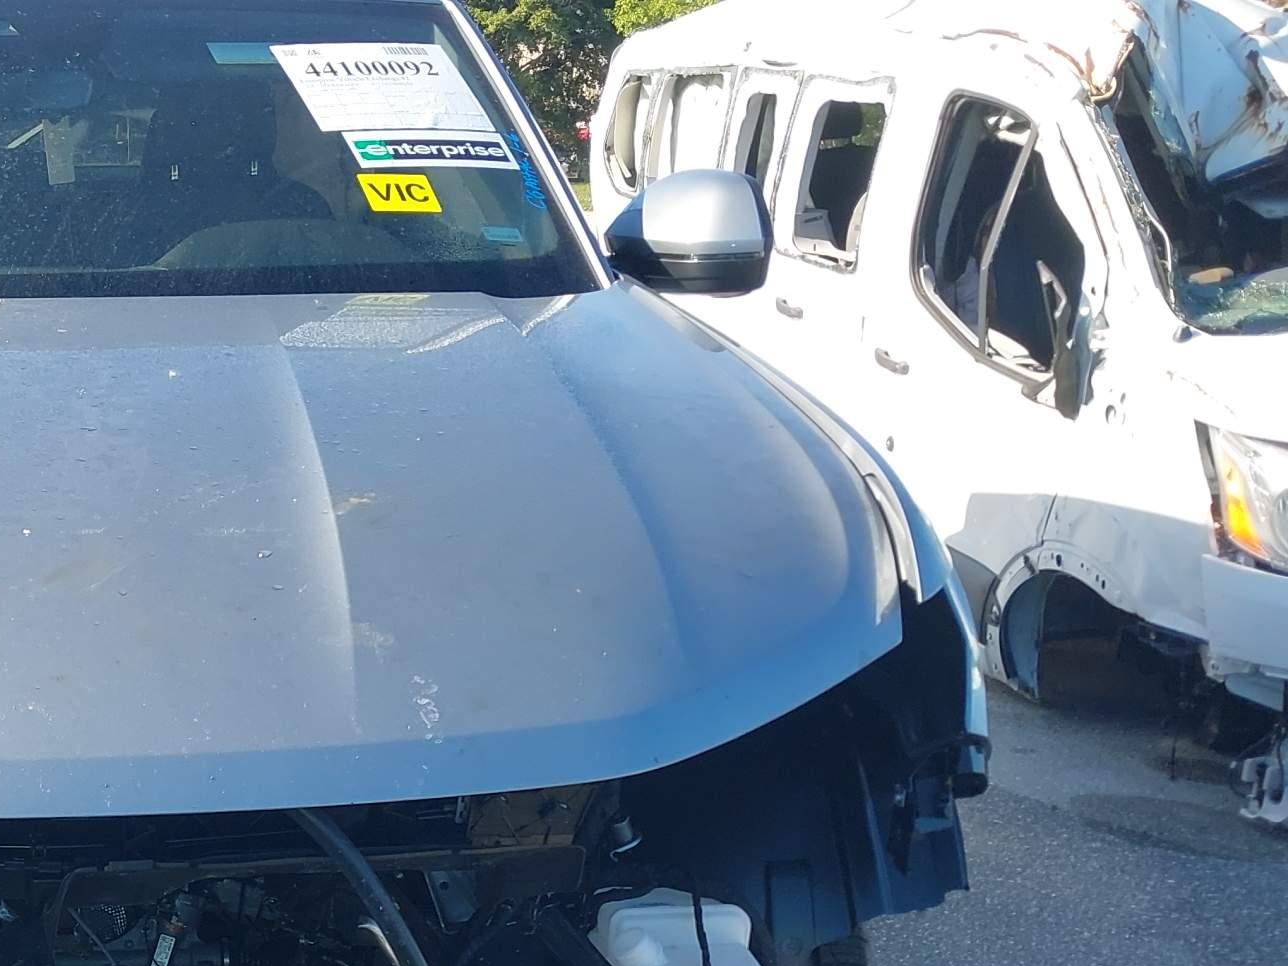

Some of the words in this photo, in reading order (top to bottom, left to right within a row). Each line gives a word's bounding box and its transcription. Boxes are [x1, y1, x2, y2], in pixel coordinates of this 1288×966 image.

[304, 60, 440, 78] 44100092
[363, 143, 505, 158] enterprise
[367, 183, 430, 203] VIC
